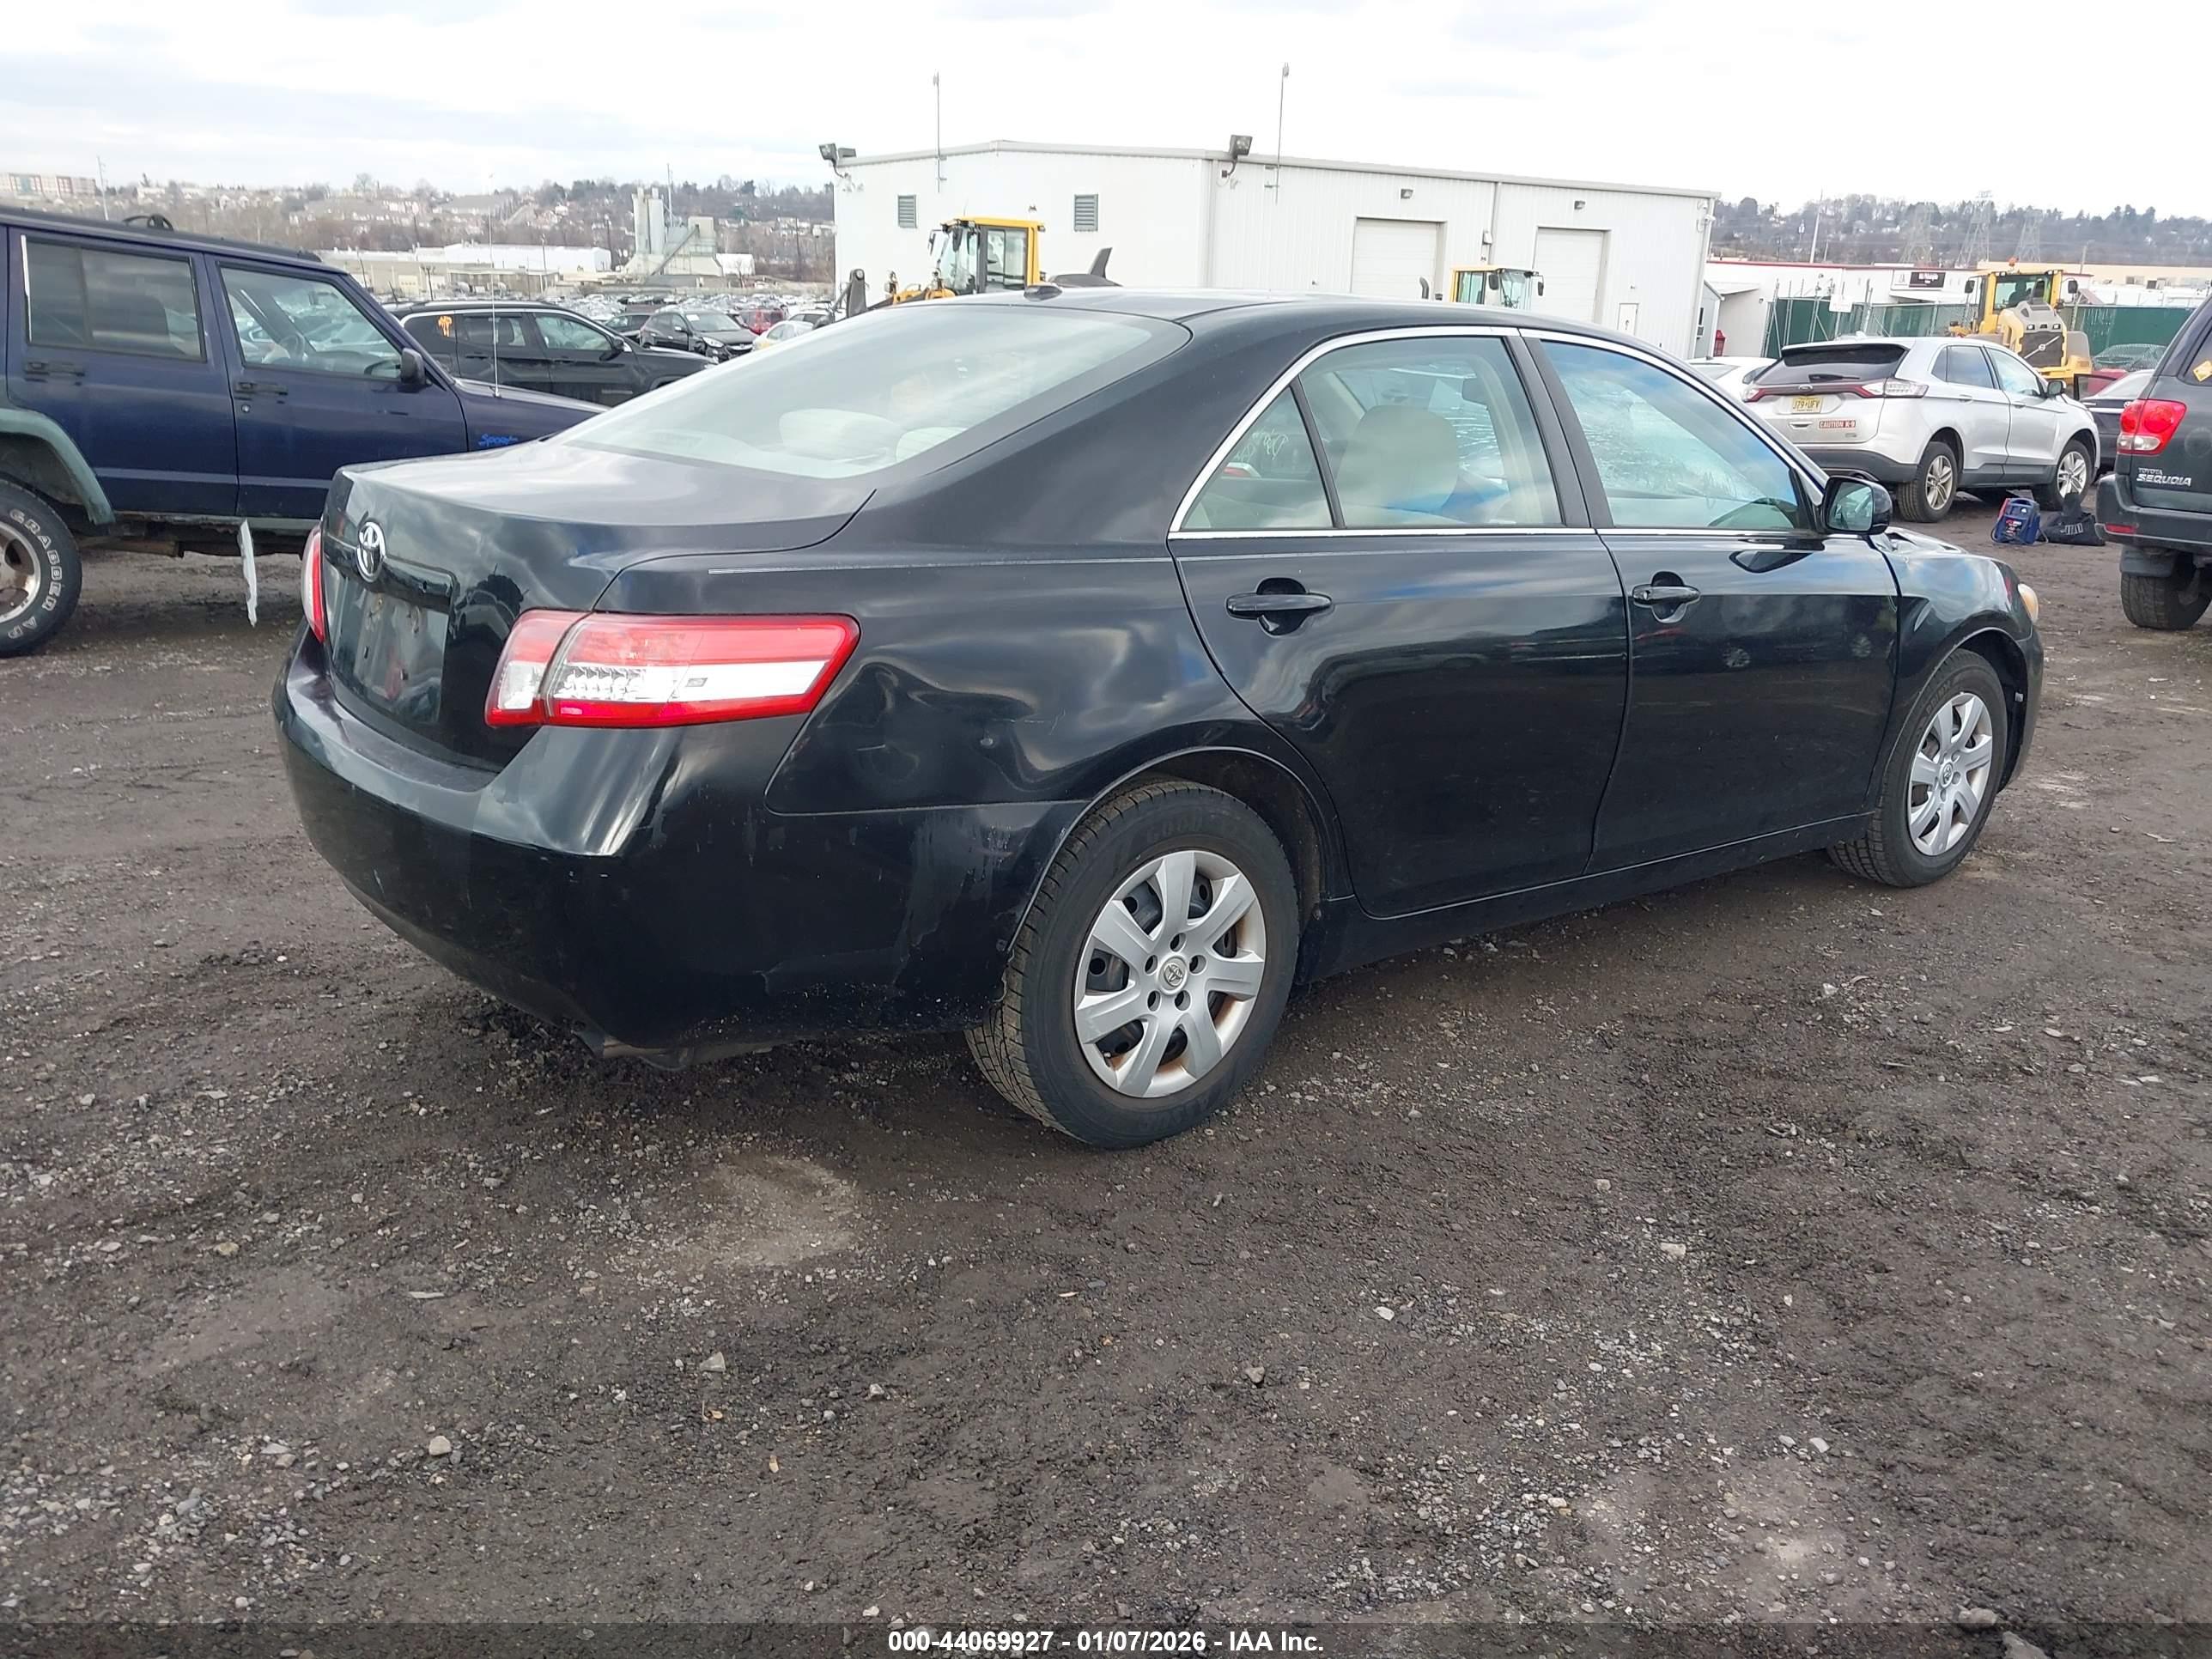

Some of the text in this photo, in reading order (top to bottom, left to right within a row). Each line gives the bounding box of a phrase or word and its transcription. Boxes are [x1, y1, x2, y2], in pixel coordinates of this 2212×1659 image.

[477, 434, 518, 447] Sport
[2136, 473, 2192, 487] SEQUOIA
[9, 508, 62, 611] GRABBER
